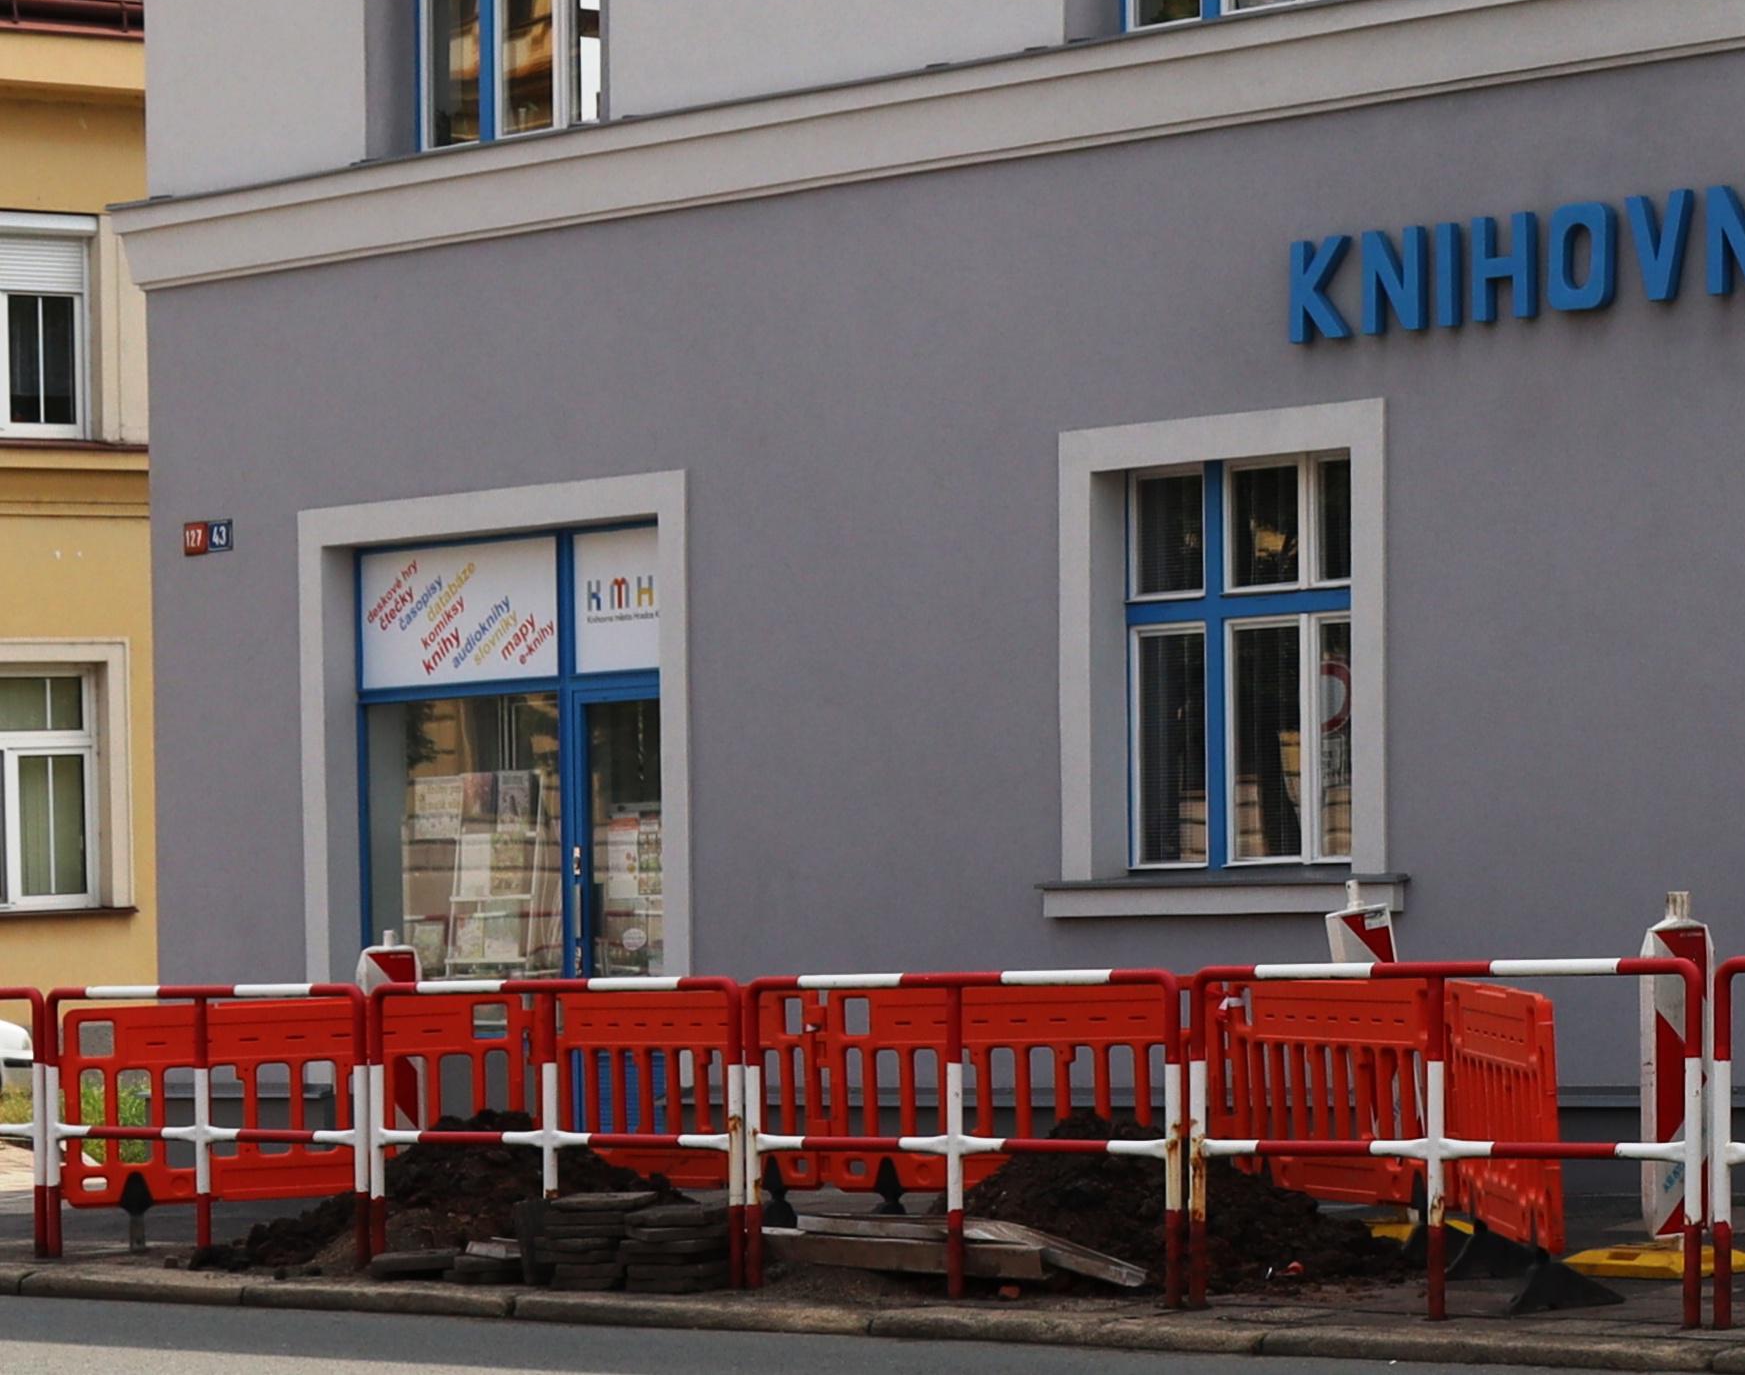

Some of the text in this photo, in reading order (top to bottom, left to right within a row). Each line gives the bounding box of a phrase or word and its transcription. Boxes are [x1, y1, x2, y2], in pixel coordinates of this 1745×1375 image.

[186, 529, 202, 547] 127
[212, 526, 226, 545] 43
[367, 560, 419, 624] deskové hry
[379, 586, 415, 631] čtečky
[399, 575, 443, 631] časopisy
[426, 562, 476, 623] databáze
[420, 596, 466, 650] komiksy
[453, 596, 511, 669] audioknihy
[473, 610, 518, 666] slovníky
[500, 613, 538, 661] mapy
[518, 620, 556, 665] e-knihy
[421, 627, 461, 675] knihy
